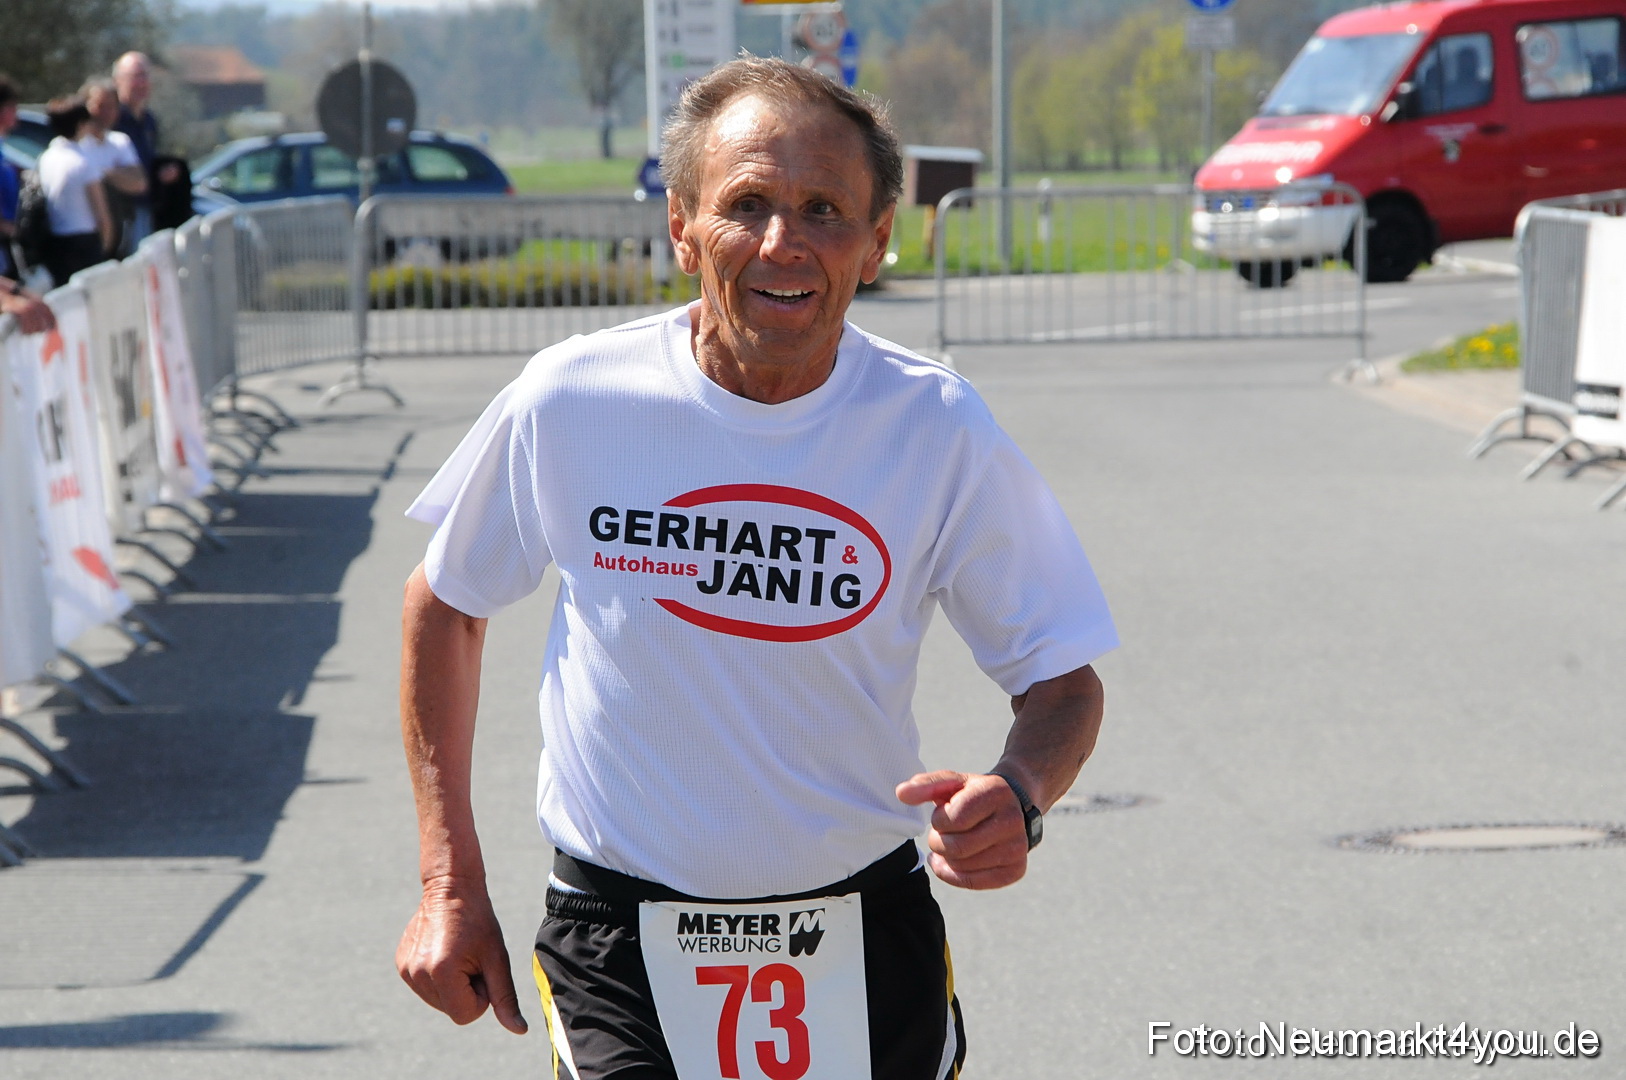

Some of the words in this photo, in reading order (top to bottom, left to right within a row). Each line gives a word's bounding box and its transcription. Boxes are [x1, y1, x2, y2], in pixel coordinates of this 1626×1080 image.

[589, 506, 836, 564] GERHART
[842, 545, 858, 565] &
[593, 552, 699, 577] Autohaus
[697, 560, 861, 609] JÄNIG
[677, 913, 781, 935] MEYER
[677, 937, 782, 953] WERBUNG
[695, 963, 811, 1080] 73
